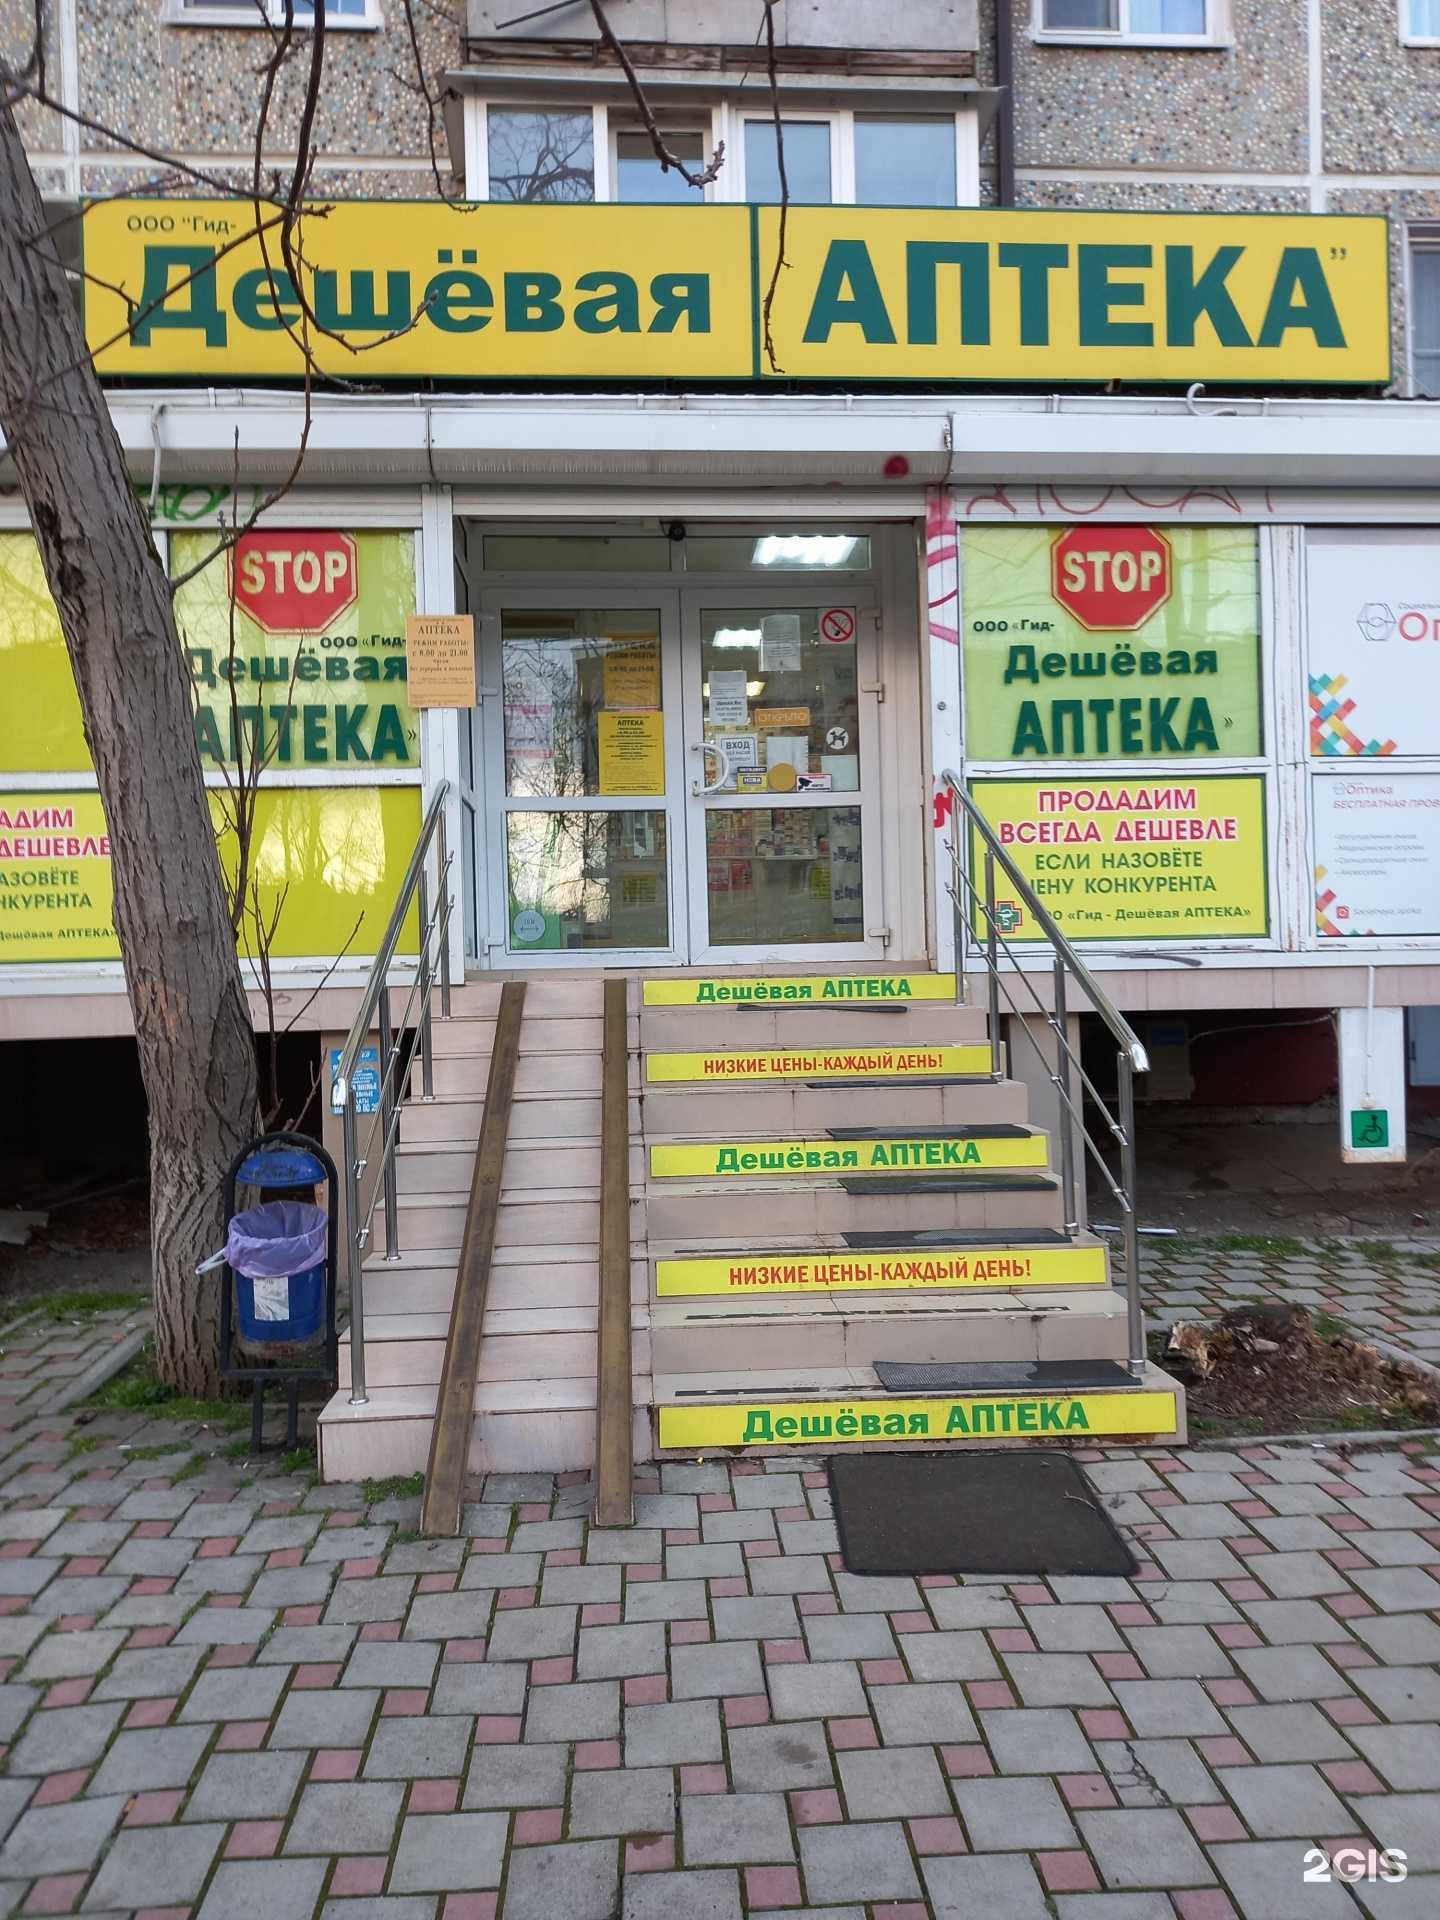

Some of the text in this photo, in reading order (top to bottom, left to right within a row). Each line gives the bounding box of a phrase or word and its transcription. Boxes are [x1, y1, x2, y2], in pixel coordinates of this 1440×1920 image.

[127, 215, 175, 232] ООО
[129, 246, 712, 348] Дешёвая
[241, 549, 348, 594] STOP
[1063, 549, 1162, 593] STOP
[418, 625, 460, 635] АПТЕКА
[973, 620, 1008, 632] ООО
[320, 636, 358, 649] ООО
[184, 648, 408, 688] Дешёвая
[1004, 643, 1218, 685] Дешёвая
[1039, 789, 1196, 812] ПРОДАДИМ
[1000, 818, 1236, 844] ВСЕГДА ДЕШЕВЛЕ
[1036, 847, 1203, 870] ЕСЛИ НАЗОВЁТЕ
[1085, 876, 1217, 894] КОНКУРЕНТА
[1115, 908, 1180, 921] Дешёвая
[696, 978, 912, 1003] Дешёвая АПТЕКА
[704, 1056, 766, 1074] НИЗКИЕ
[897, 1053, 943, 1072] ДЕНЬ!
[716, 1141, 981, 1173] Дешёвая АПТЕКА
[729, 1265, 809, 1286] НИЗКИЕ
[973, 1258, 1032, 1281] ДЕНЬ!
[743, 1401, 1089, 1443] Дешёвая АПТЕКА
